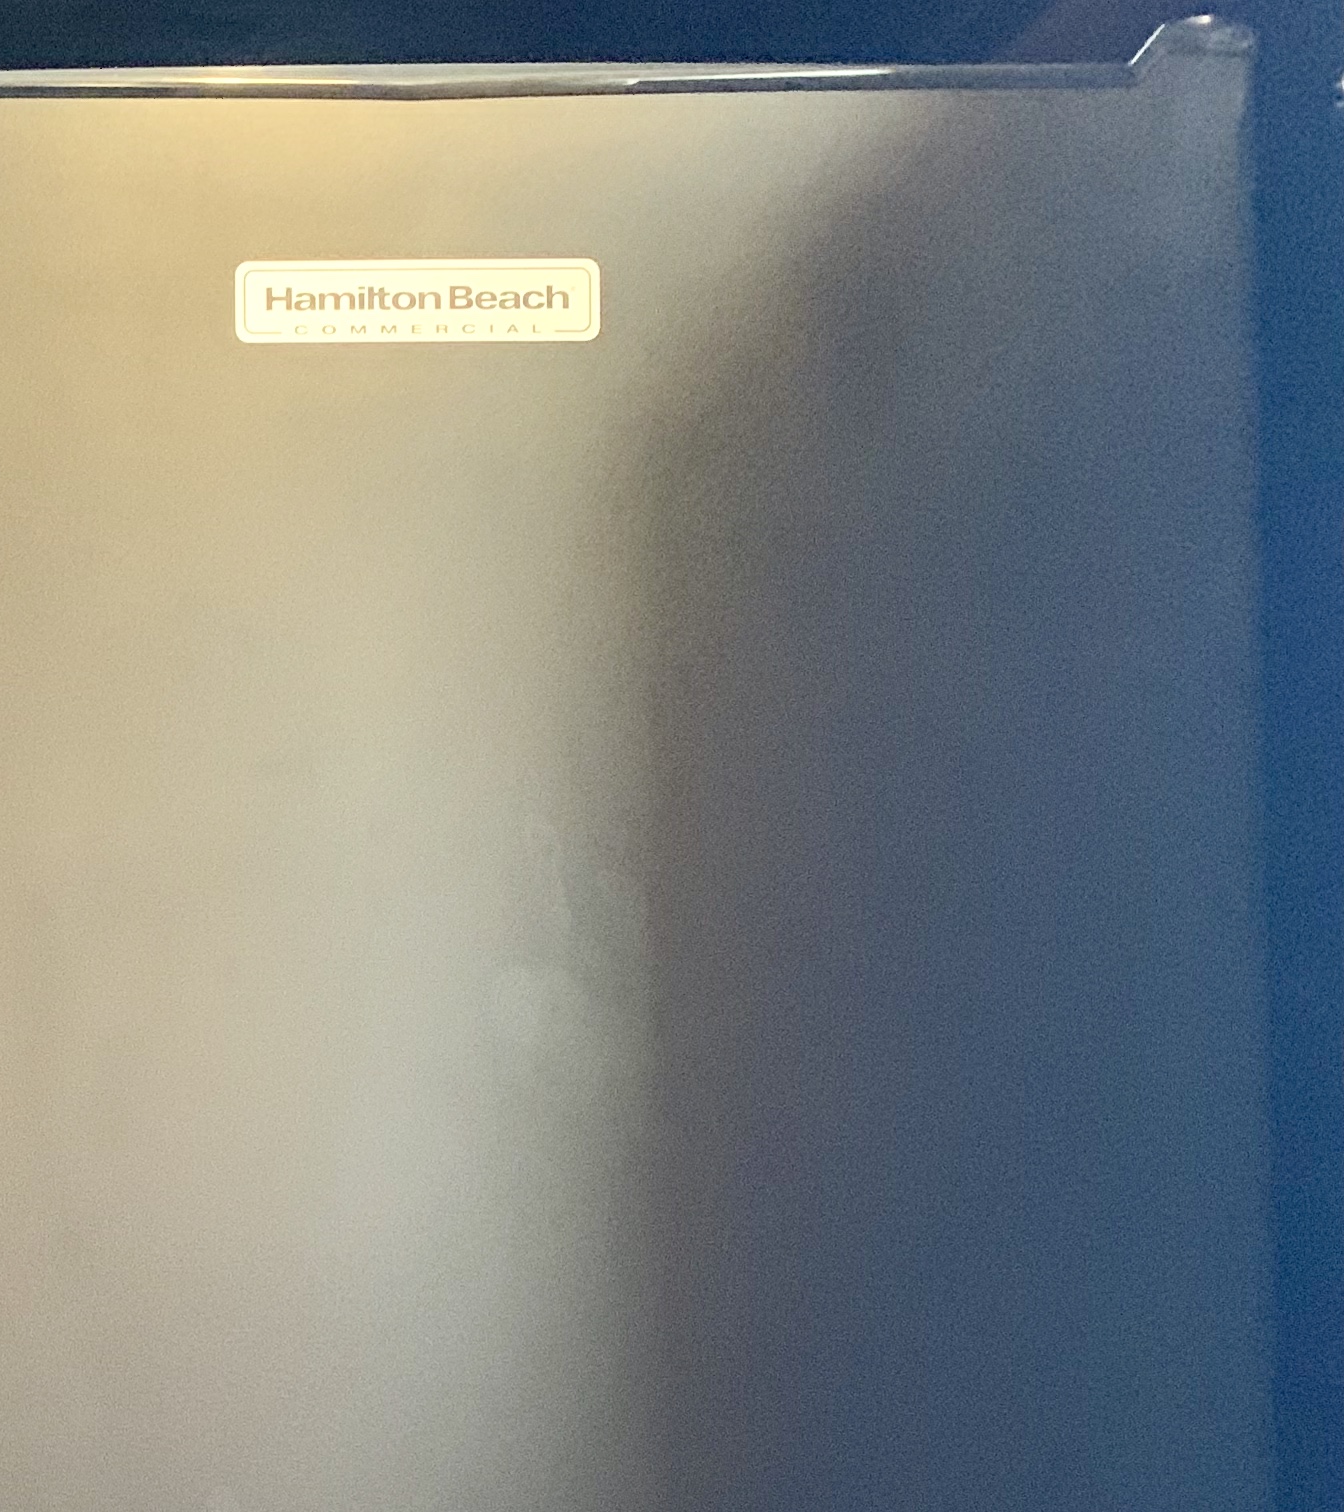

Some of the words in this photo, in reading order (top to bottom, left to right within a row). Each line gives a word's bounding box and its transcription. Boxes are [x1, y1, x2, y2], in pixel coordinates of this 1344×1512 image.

[265, 285, 442, 311] Hamilton
[448, 285, 570, 310] Beach
[294, 324, 542, 335] COMMERCIAL
